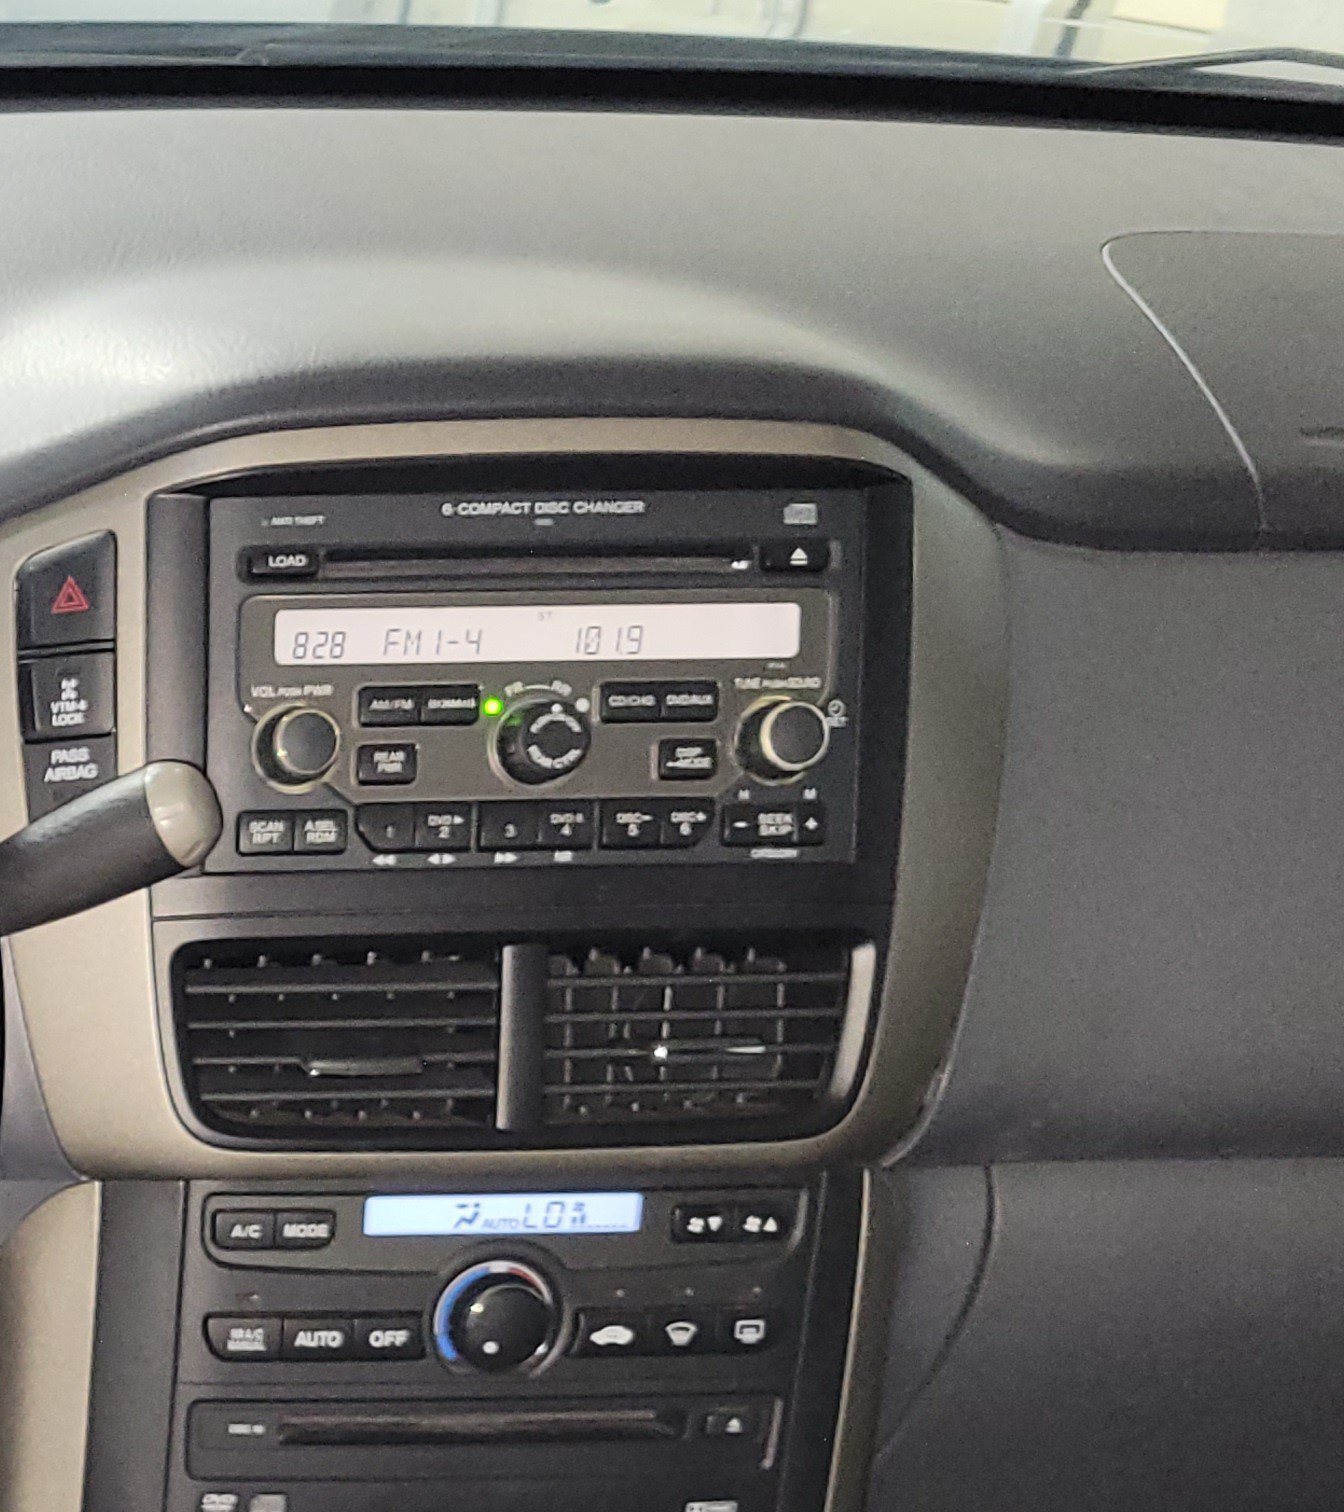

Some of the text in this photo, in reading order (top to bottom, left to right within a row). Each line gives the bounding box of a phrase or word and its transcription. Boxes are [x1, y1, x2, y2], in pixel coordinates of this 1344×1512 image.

[457, 501, 531, 515] COMPACT
[534, 501, 570, 515] DISC
[572, 500, 646, 515] CHANGER
[268, 554, 309, 568] LOAD
[292, 631, 346, 659] 828
[251, 684, 277, 697] VOL
[52, 714, 85, 727] LOCK
[51, 748, 90, 765] PASS
[44, 764, 99, 782] AIRBAG
[386, 825, 395, 839] 1
[438, 826, 450, 839] 2
[230, 1224, 262, 1238] A/C
[283, 1223, 330, 1238] MODE
[294, 1330, 344, 1348] AUTO
[368, 1329, 410, 1347] OFF
